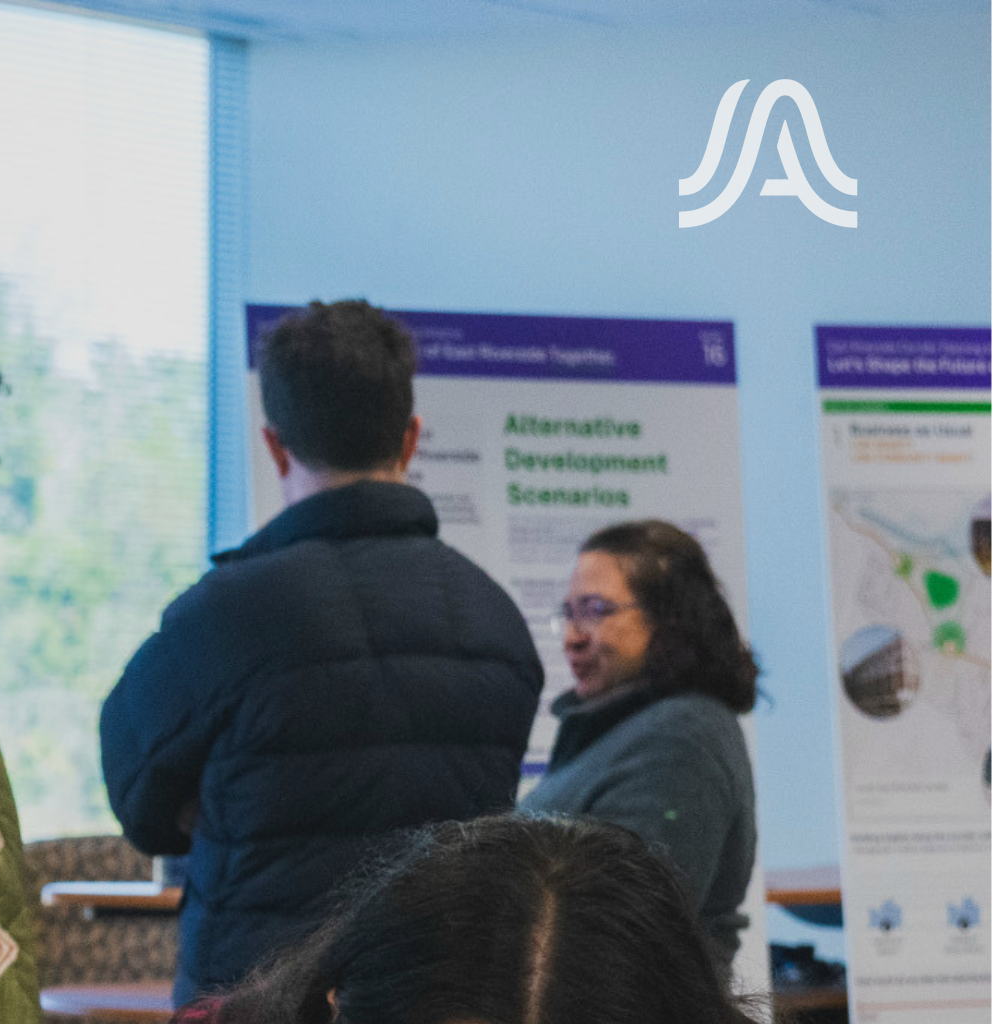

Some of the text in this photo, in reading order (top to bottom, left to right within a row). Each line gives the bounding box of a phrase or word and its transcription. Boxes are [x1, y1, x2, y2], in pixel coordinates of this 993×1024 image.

[505, 414, 641, 439] Alternative
[506, 448, 667, 475] Development
[507, 481, 630, 507] Scenarios
